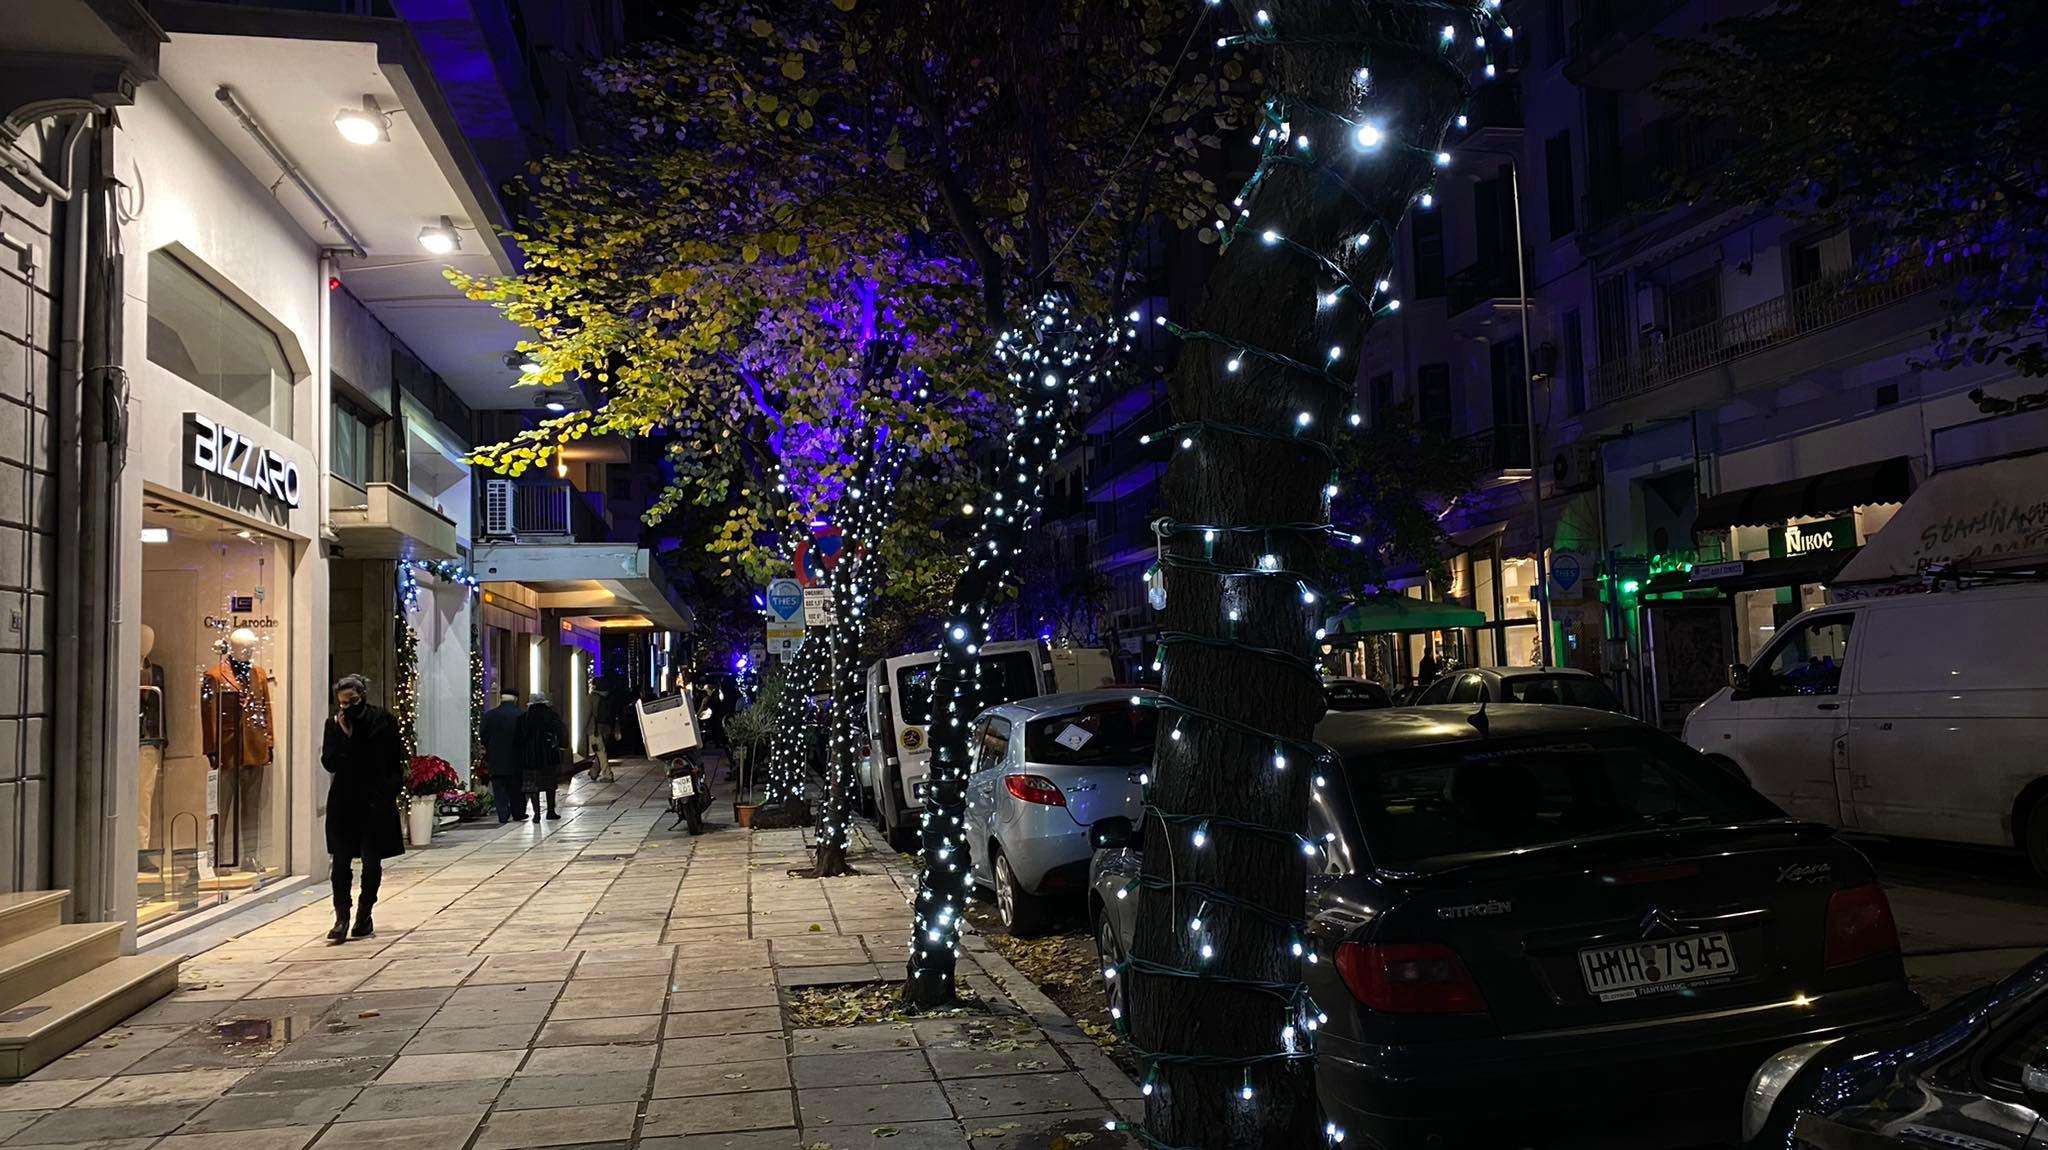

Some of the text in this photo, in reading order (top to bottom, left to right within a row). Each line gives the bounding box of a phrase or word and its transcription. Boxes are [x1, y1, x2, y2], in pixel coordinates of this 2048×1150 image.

[194, 415, 300, 506] BIZZARO
[773, 597, 797, 606] THES
[204, 615, 279, 630] Guy Laroche
[1655, 936, 1730, 977] 7945
